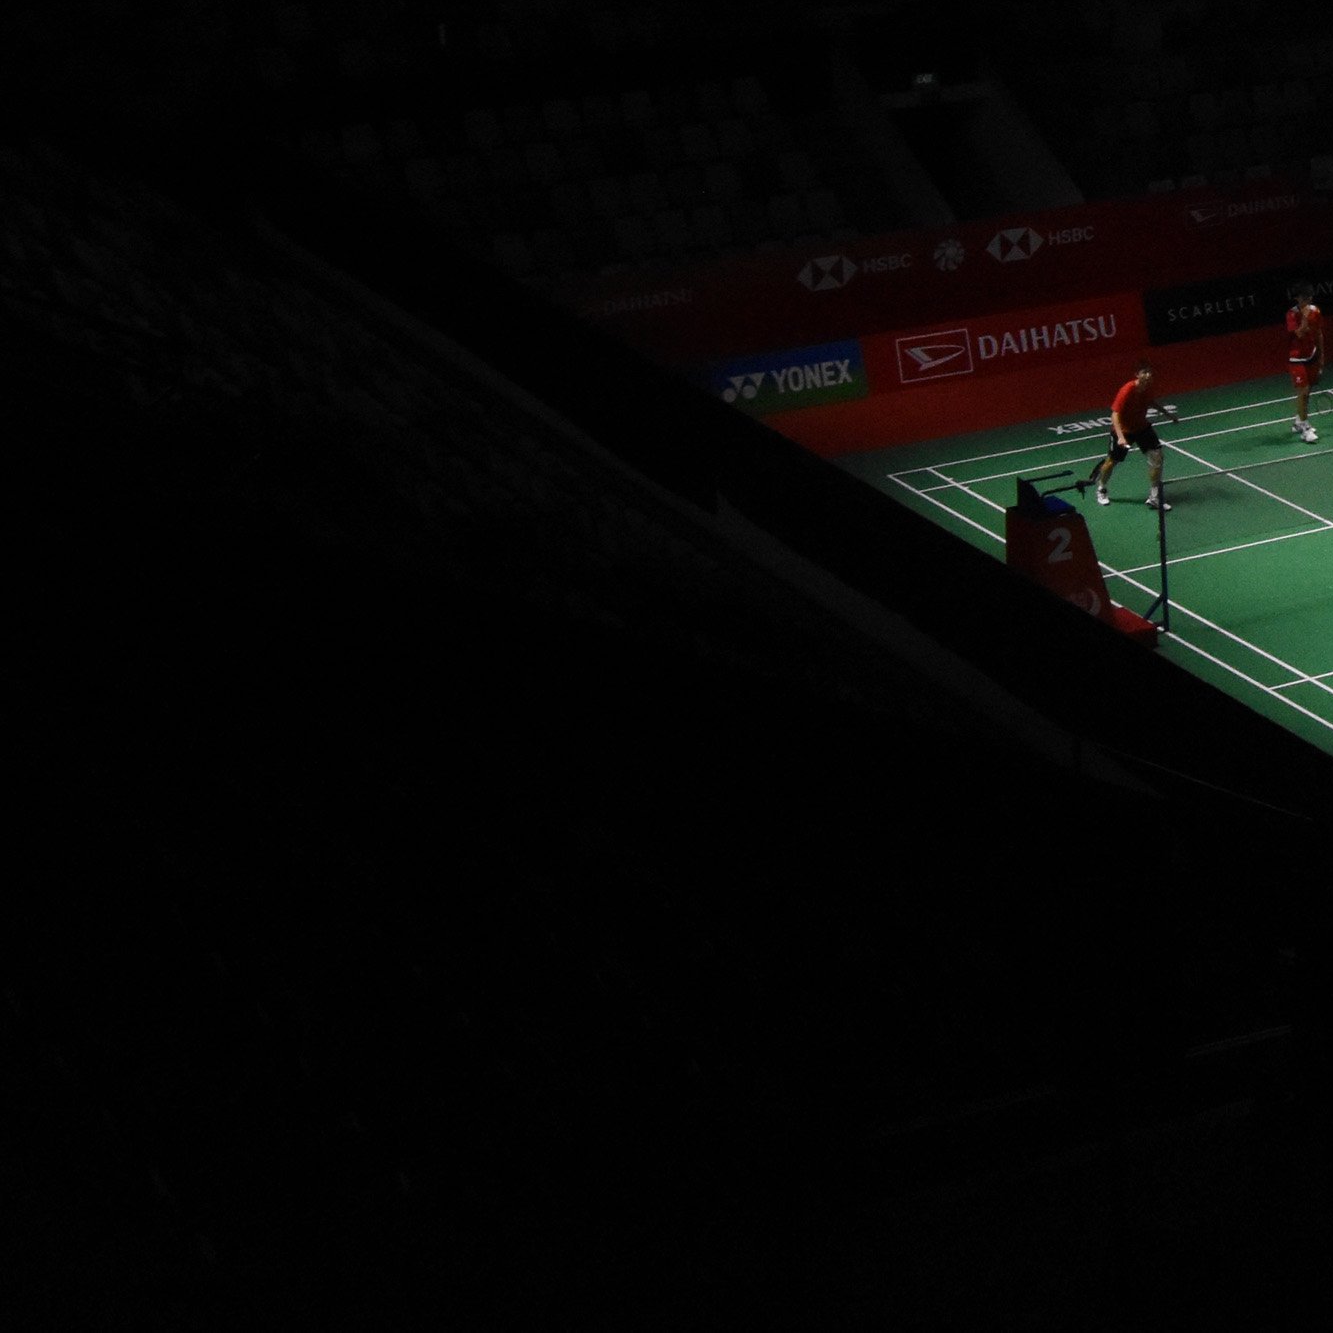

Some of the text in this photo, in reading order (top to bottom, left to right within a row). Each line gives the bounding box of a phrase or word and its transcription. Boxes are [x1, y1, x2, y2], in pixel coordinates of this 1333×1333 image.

[1048, 224, 1096, 248] HSBC
[863, 252, 913, 274] HSBC
[1166, 293, 1258, 323] SCARLETT
[977, 314, 1119, 360] DAIHATSU
[771, 358, 853, 394] YONEX
[1046, 527, 1073, 564] 2
